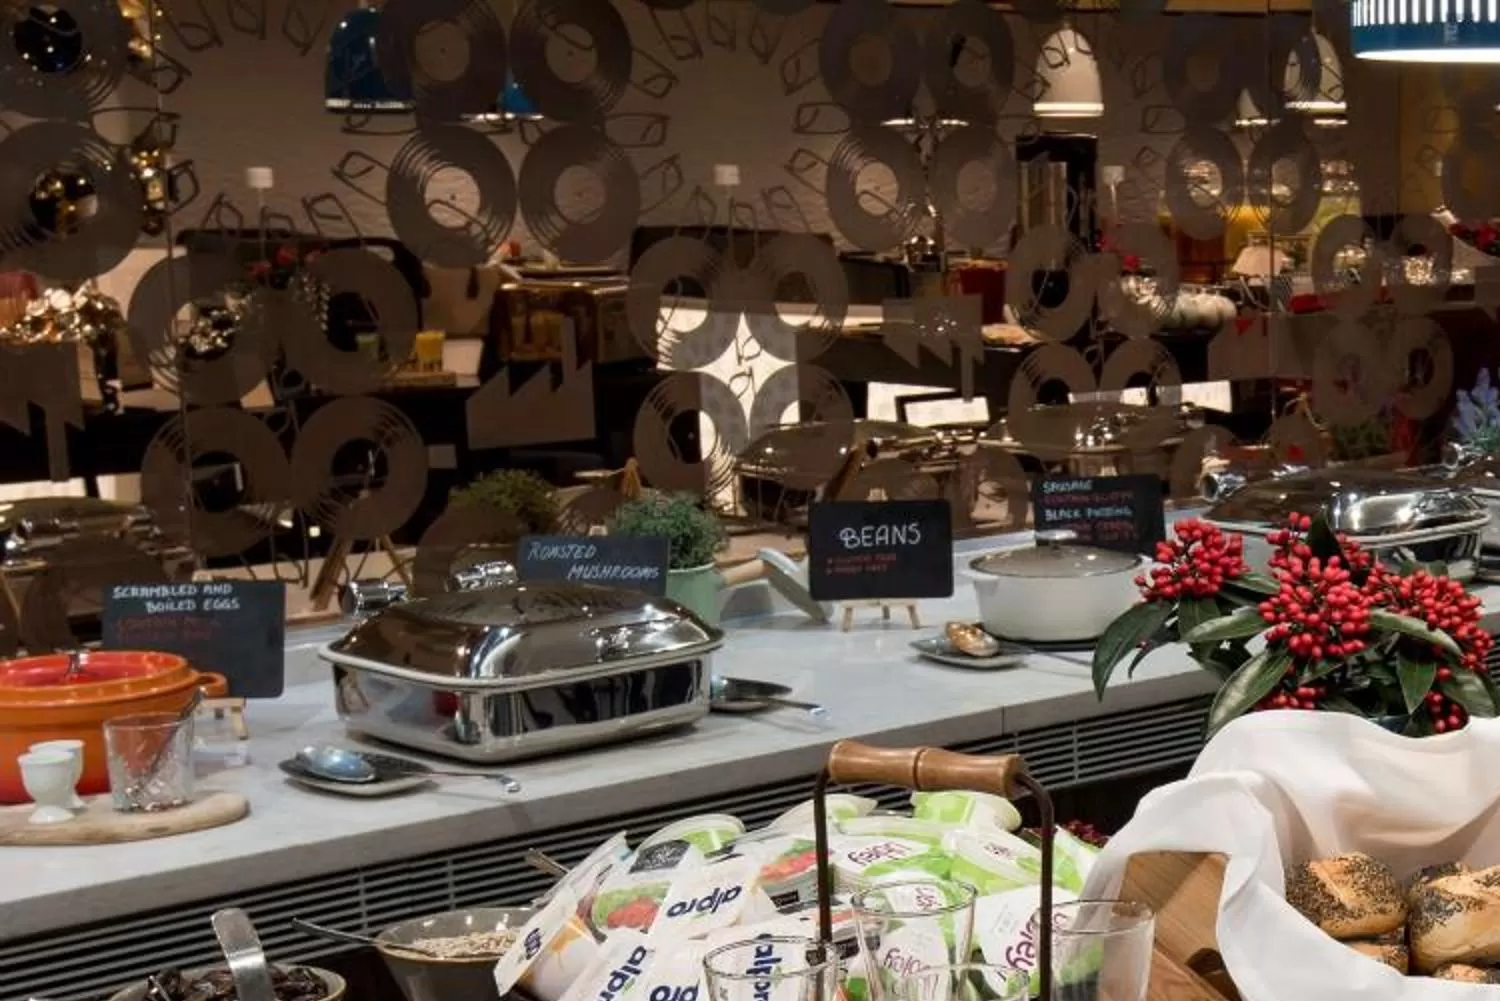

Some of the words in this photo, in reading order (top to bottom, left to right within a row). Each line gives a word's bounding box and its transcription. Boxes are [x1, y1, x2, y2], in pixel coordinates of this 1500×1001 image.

[1044, 508, 1081, 520] BLACK
[840, 522, 921, 549] BEANS
[528, 542, 597, 560] ROASTED
[567, 563, 660, 581] MUSHROOMS
[112, 583, 198, 599] SCRAMBLED
[203, 583, 233, 594] AND
[203, 598, 240, 610] EGGS
[667, 885, 742, 917] alpro
